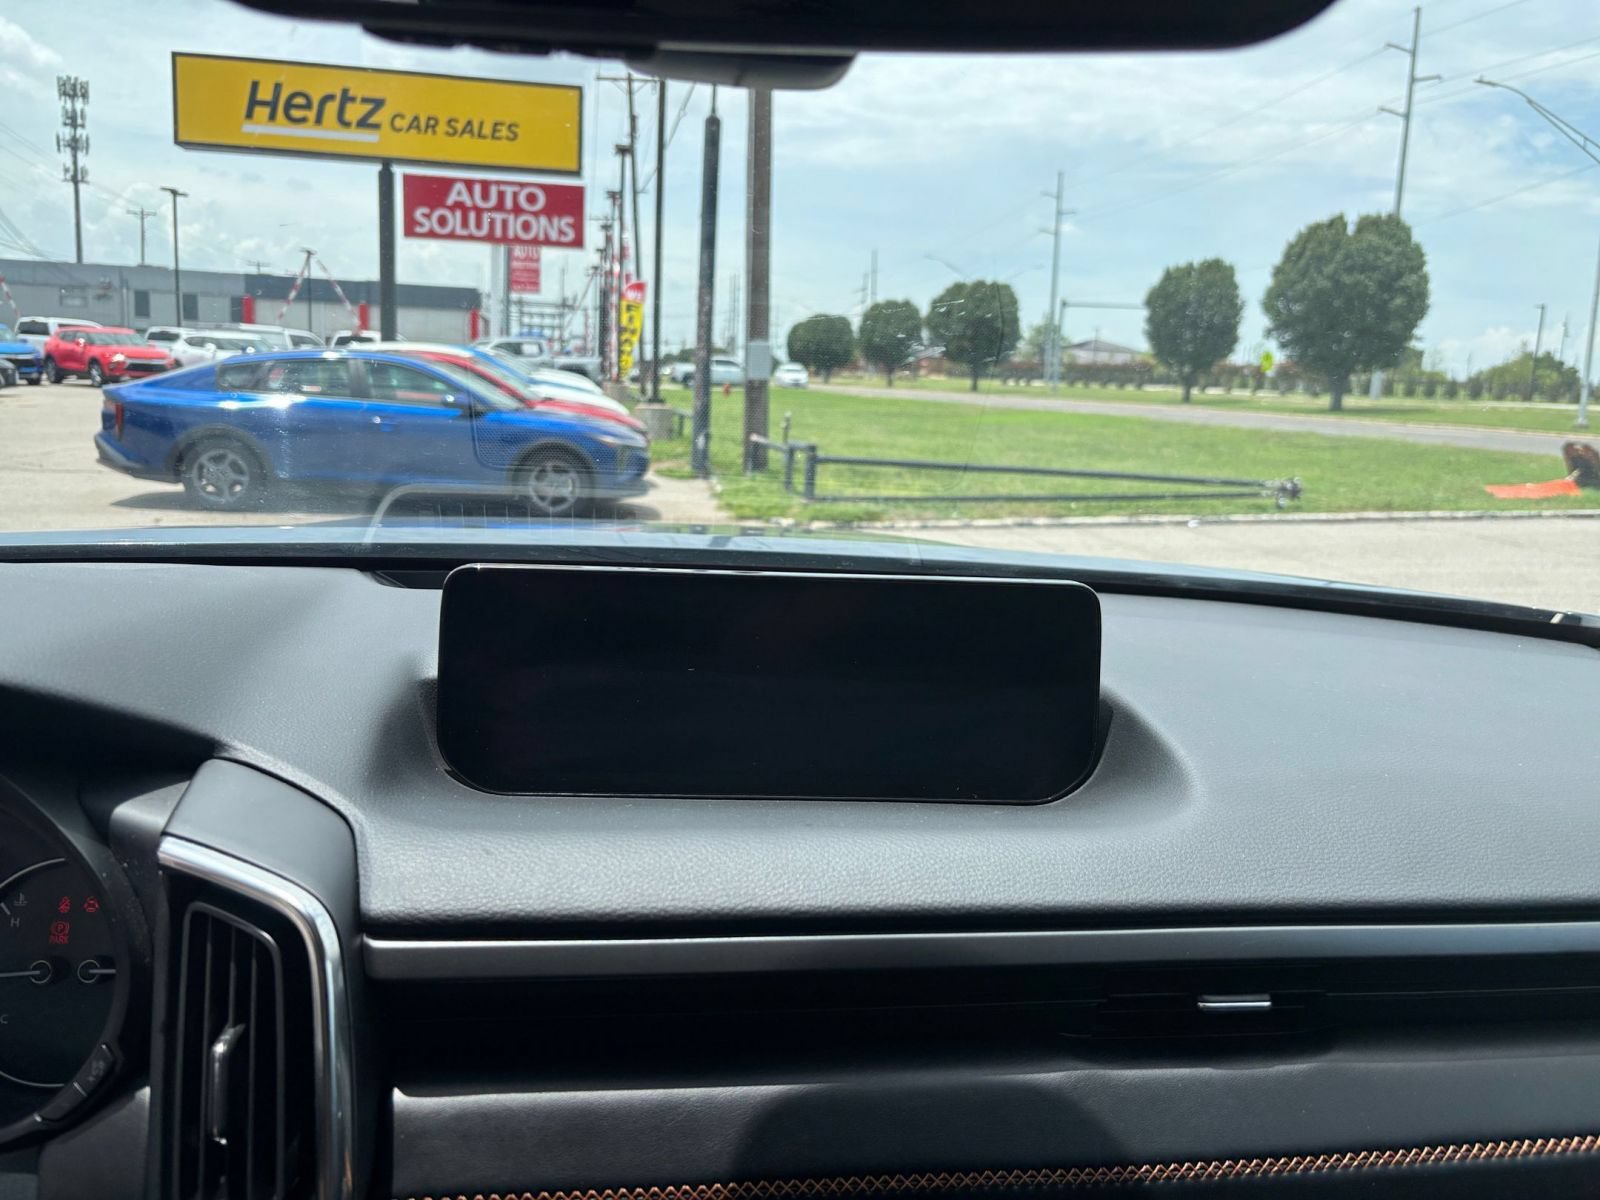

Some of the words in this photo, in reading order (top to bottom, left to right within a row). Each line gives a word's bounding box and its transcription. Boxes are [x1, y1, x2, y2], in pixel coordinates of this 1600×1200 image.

[244, 80, 387, 130] Hertz
[390, 113, 440, 137] CAR
[445, 117, 521, 142] SALES
[446, 181, 546, 212] AUTO
[413, 207, 575, 243] SOLUTIONS
